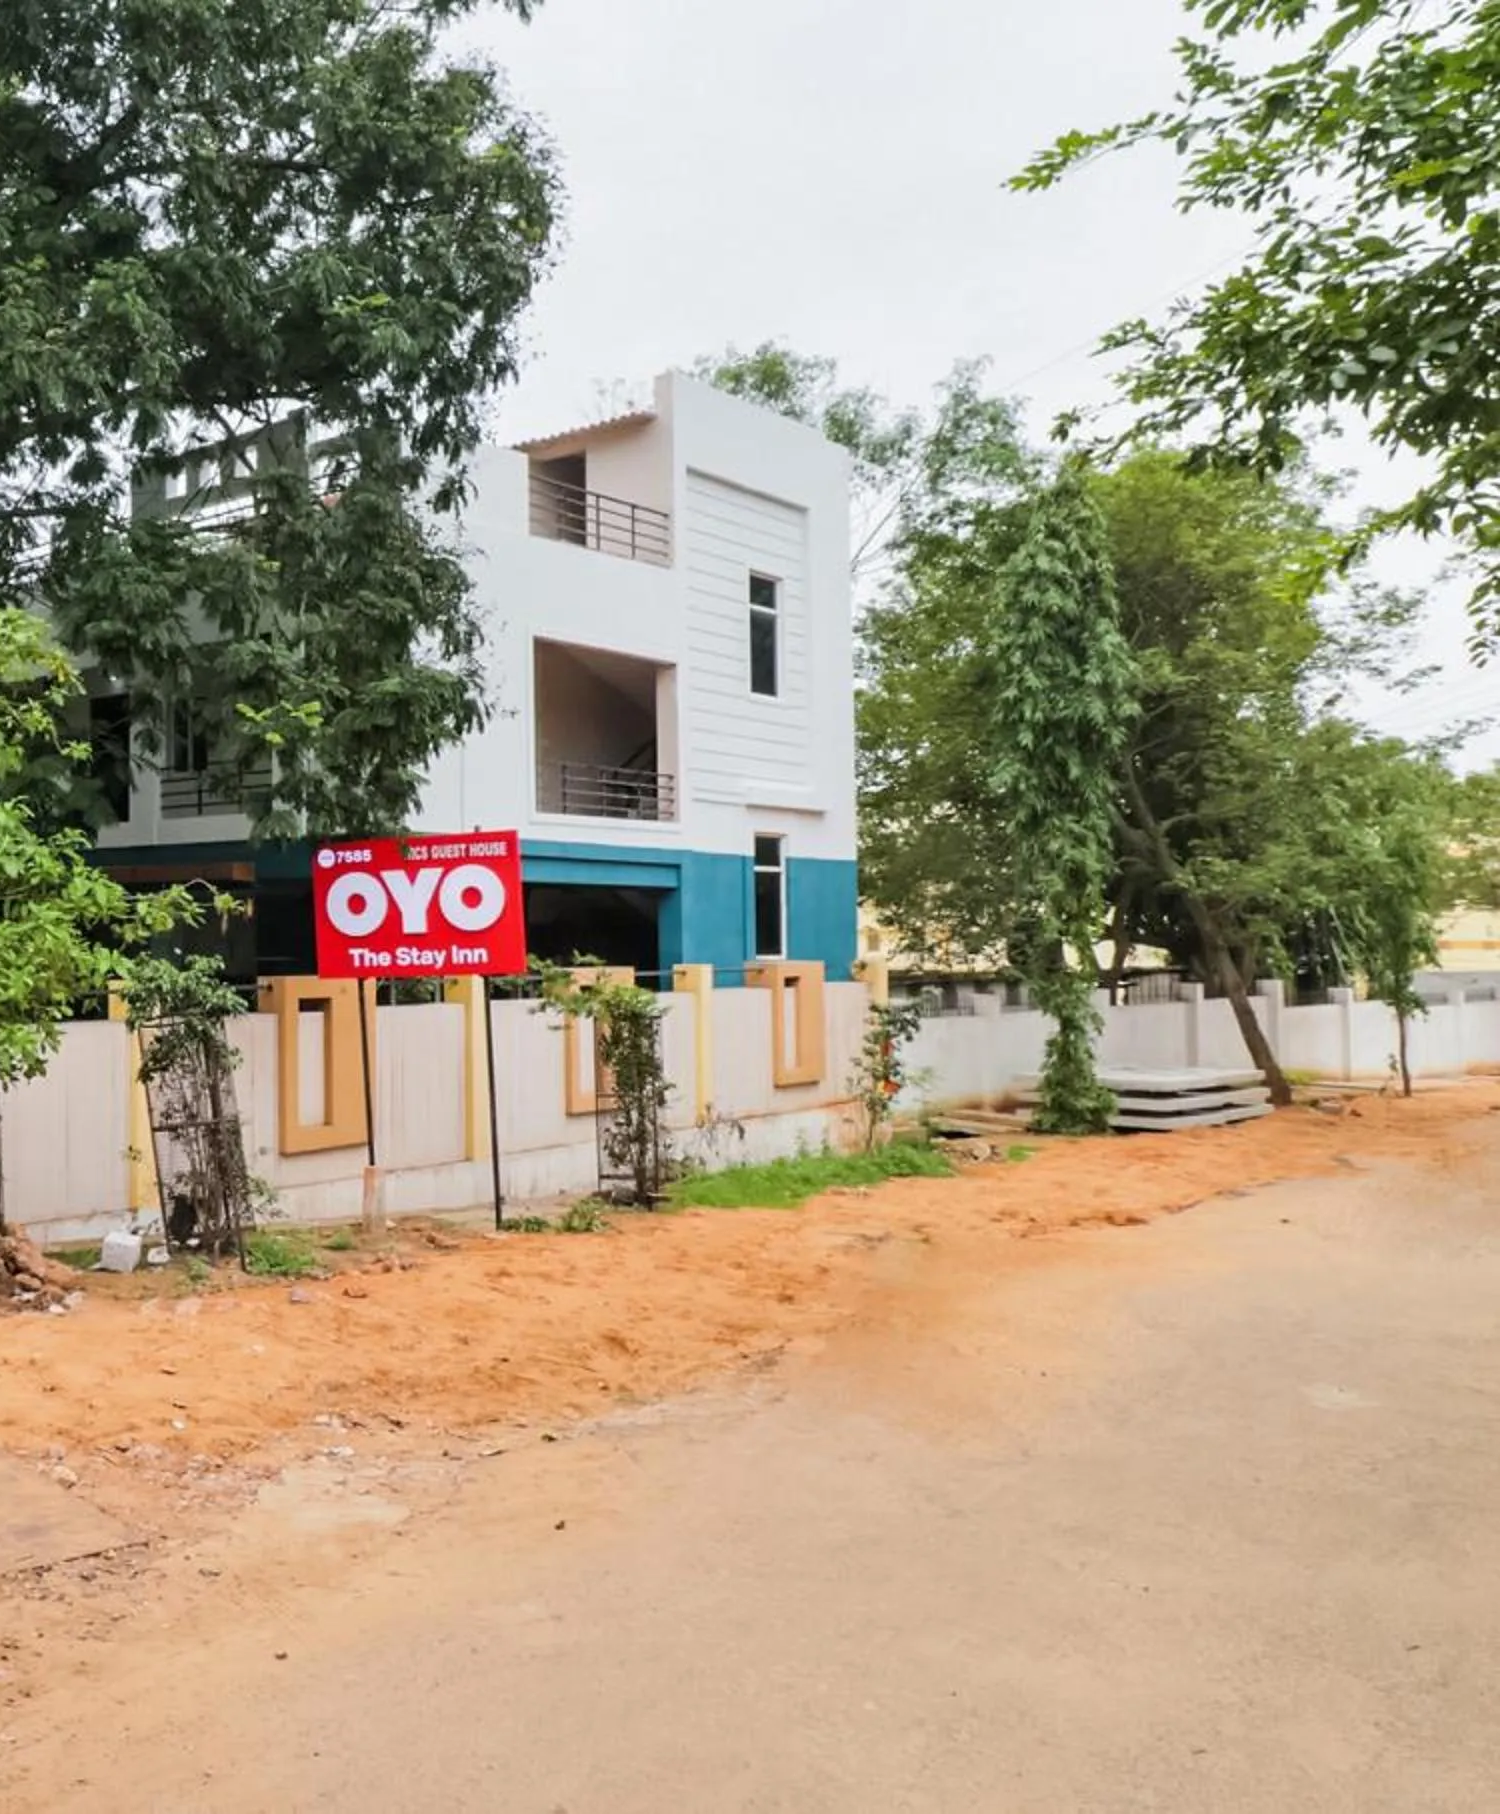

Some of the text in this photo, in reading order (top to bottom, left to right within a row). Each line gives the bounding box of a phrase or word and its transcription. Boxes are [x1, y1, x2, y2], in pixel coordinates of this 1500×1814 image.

[336, 849, 372, 864] 7585
[431, 844, 466, 860] GUEST
[469, 841, 508, 858] HOUSE
[326, 863, 506, 937] OYO
[348, 944, 489, 969] The Stay Inn
